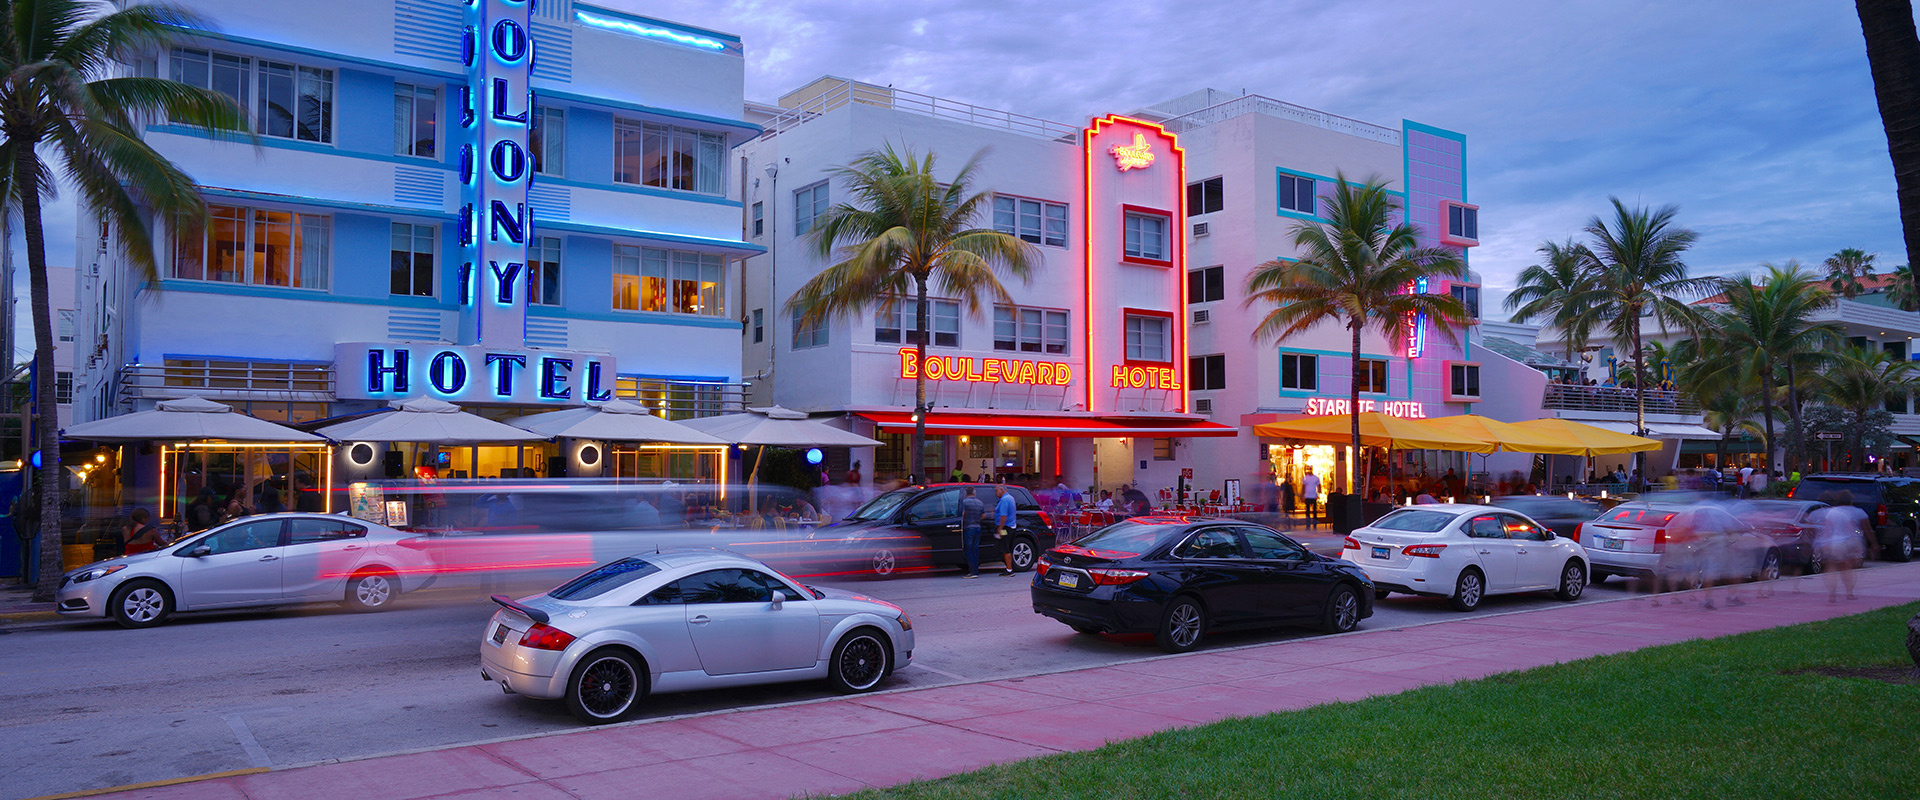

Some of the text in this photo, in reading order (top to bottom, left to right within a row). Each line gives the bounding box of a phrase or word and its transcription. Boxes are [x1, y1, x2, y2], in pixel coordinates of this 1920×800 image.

[490, 0, 527, 304] OLONY
[368, 349, 612, 400] HOTEL
[899, 348, 1181, 390] BOULEVARD HOTEL
[1307, 398, 1426, 418] STARLTE HOTEL
